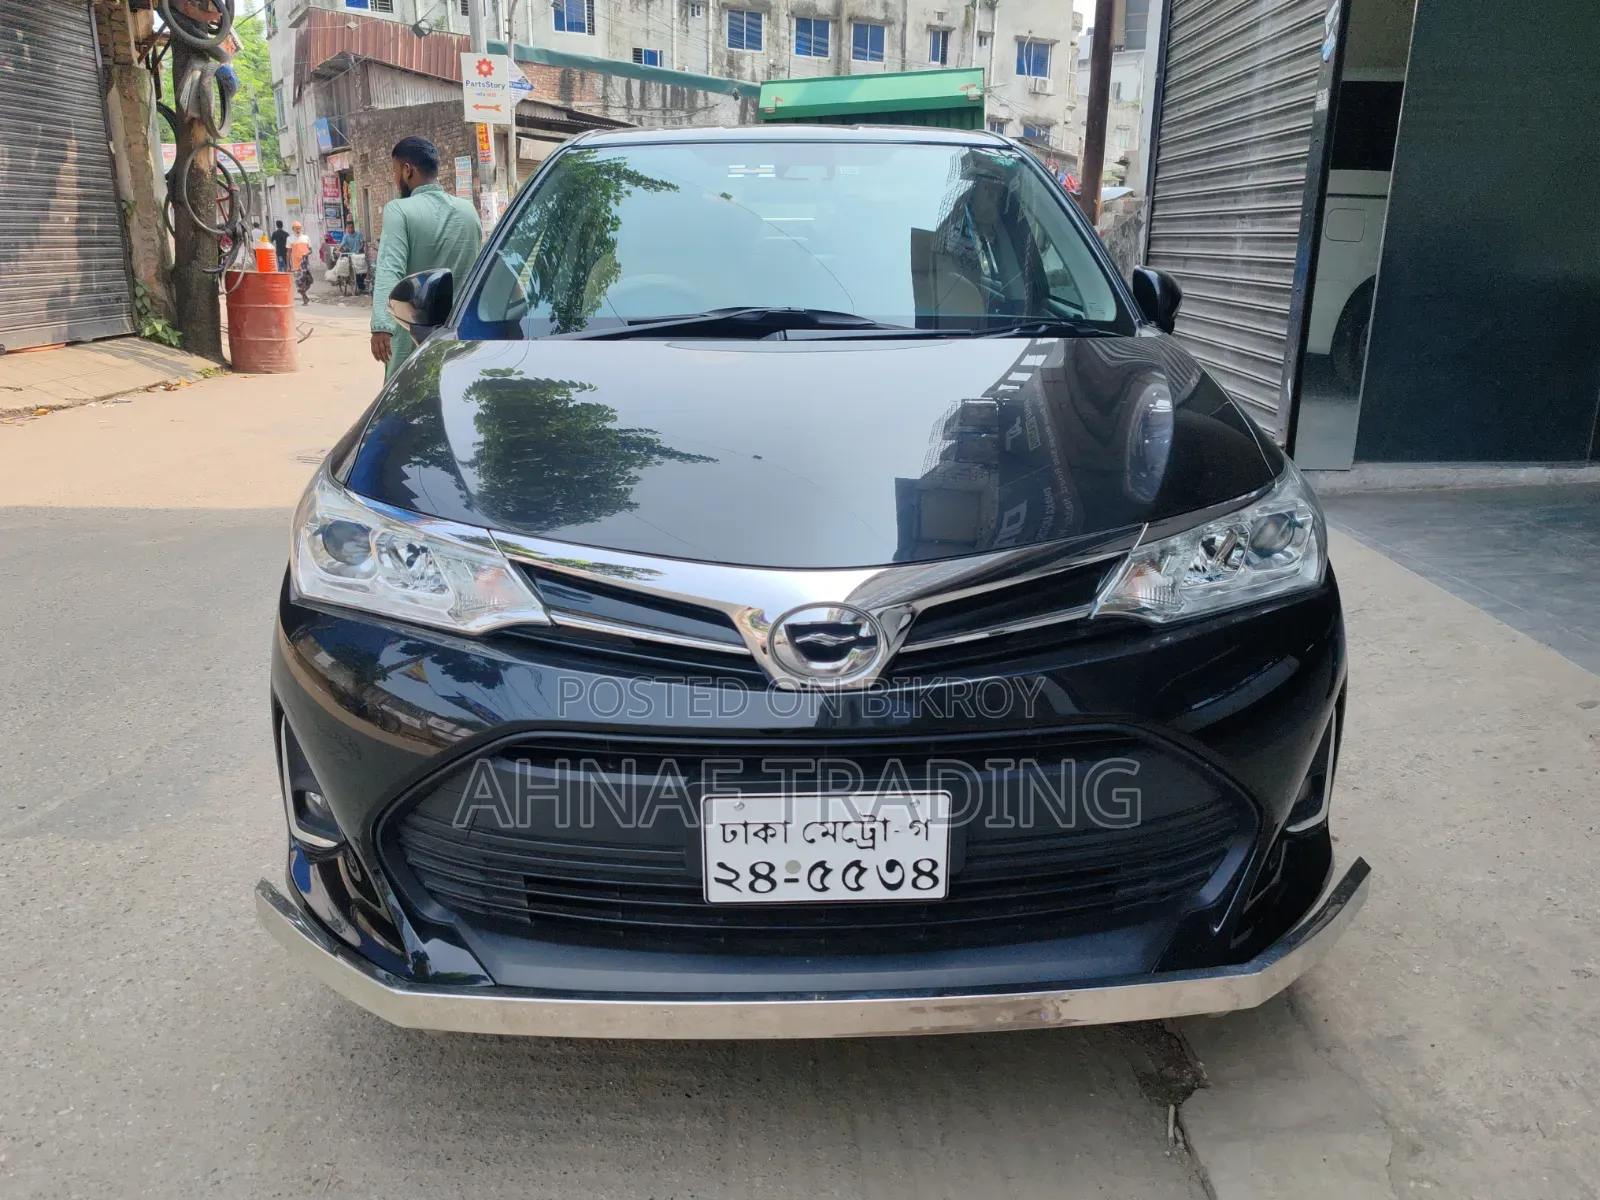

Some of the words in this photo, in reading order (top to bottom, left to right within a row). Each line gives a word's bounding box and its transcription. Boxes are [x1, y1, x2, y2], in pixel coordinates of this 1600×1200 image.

[465, 79, 506, 91] PartsStory
[719, 820, 792, 845] ঢাকা
[713, 858, 940, 894] ২৪-৫৫৩৪
